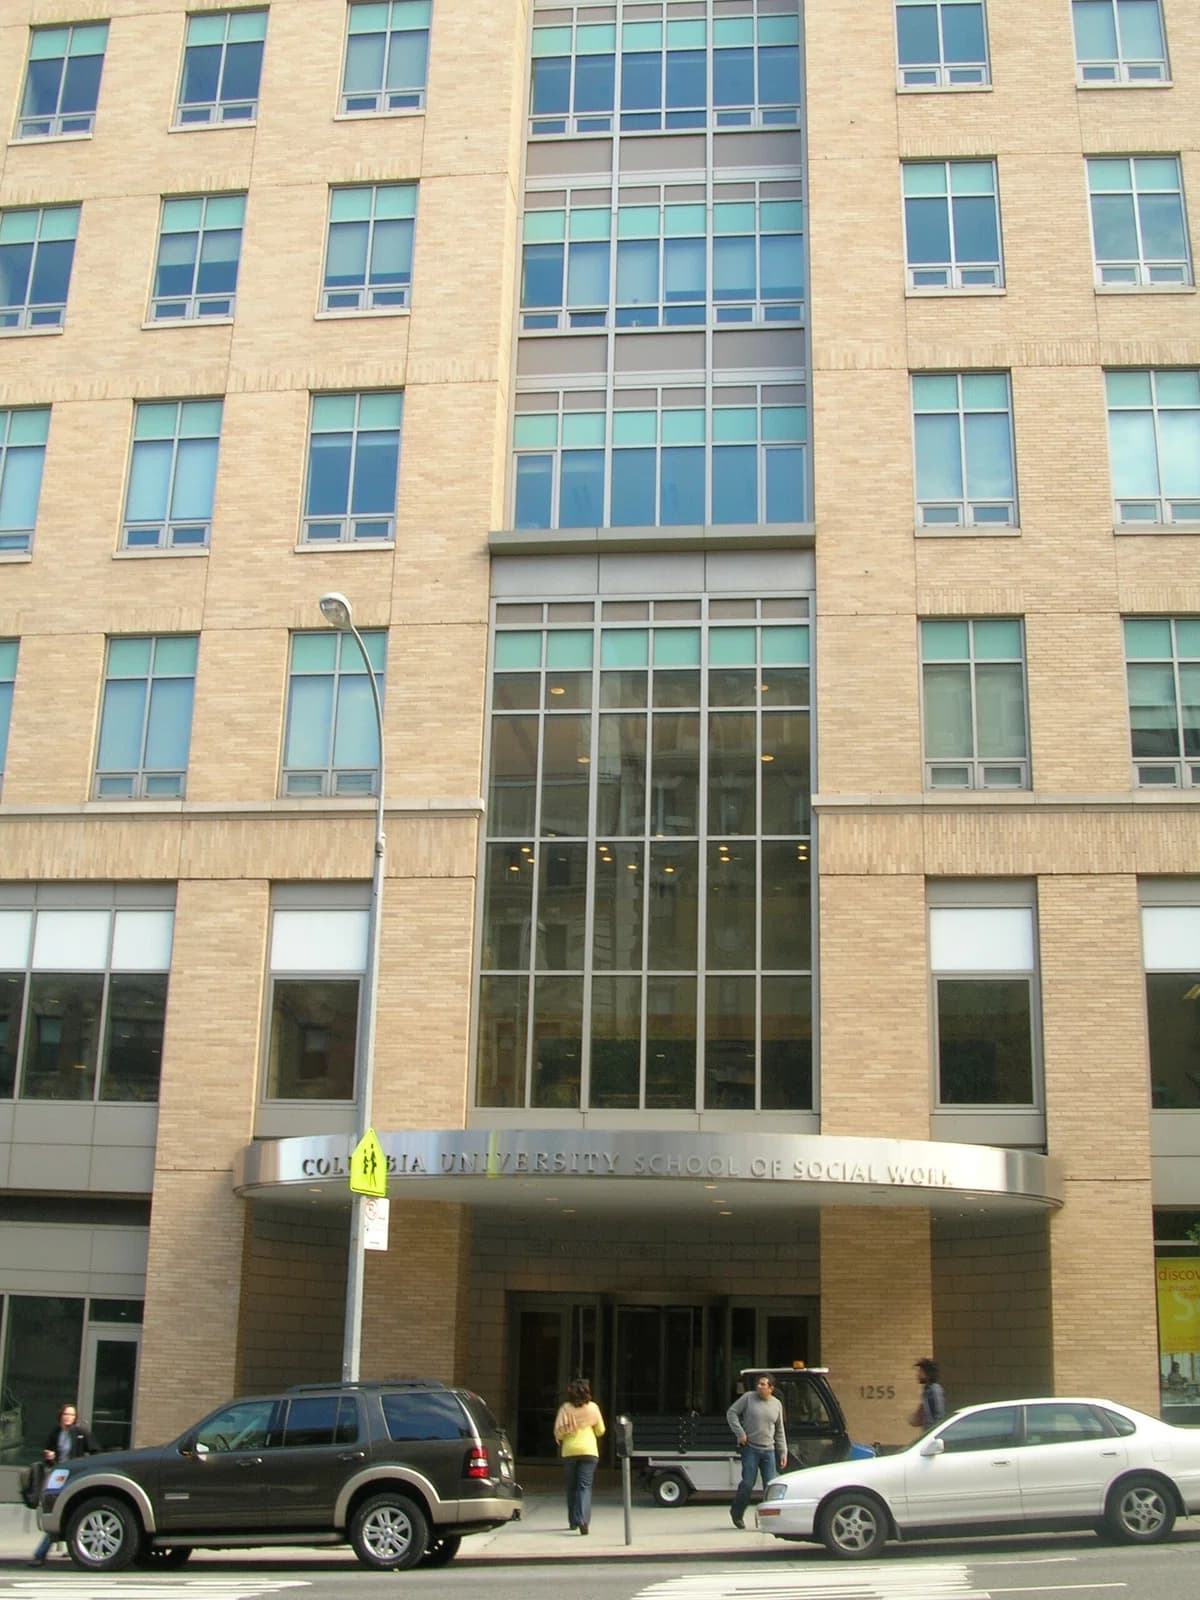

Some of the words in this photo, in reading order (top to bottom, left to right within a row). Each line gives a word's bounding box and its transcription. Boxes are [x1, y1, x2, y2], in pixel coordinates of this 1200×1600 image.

[302, 1151, 427, 1176] COLBIA
[441, 1152, 619, 1174] UNIVERSITY
[633, 1153, 739, 1177] SCHOOL
[750, 1156, 782, 1178] OF
[793, 1159, 879, 1184] SOCIAL
[859, 1384, 896, 1400] 1255
